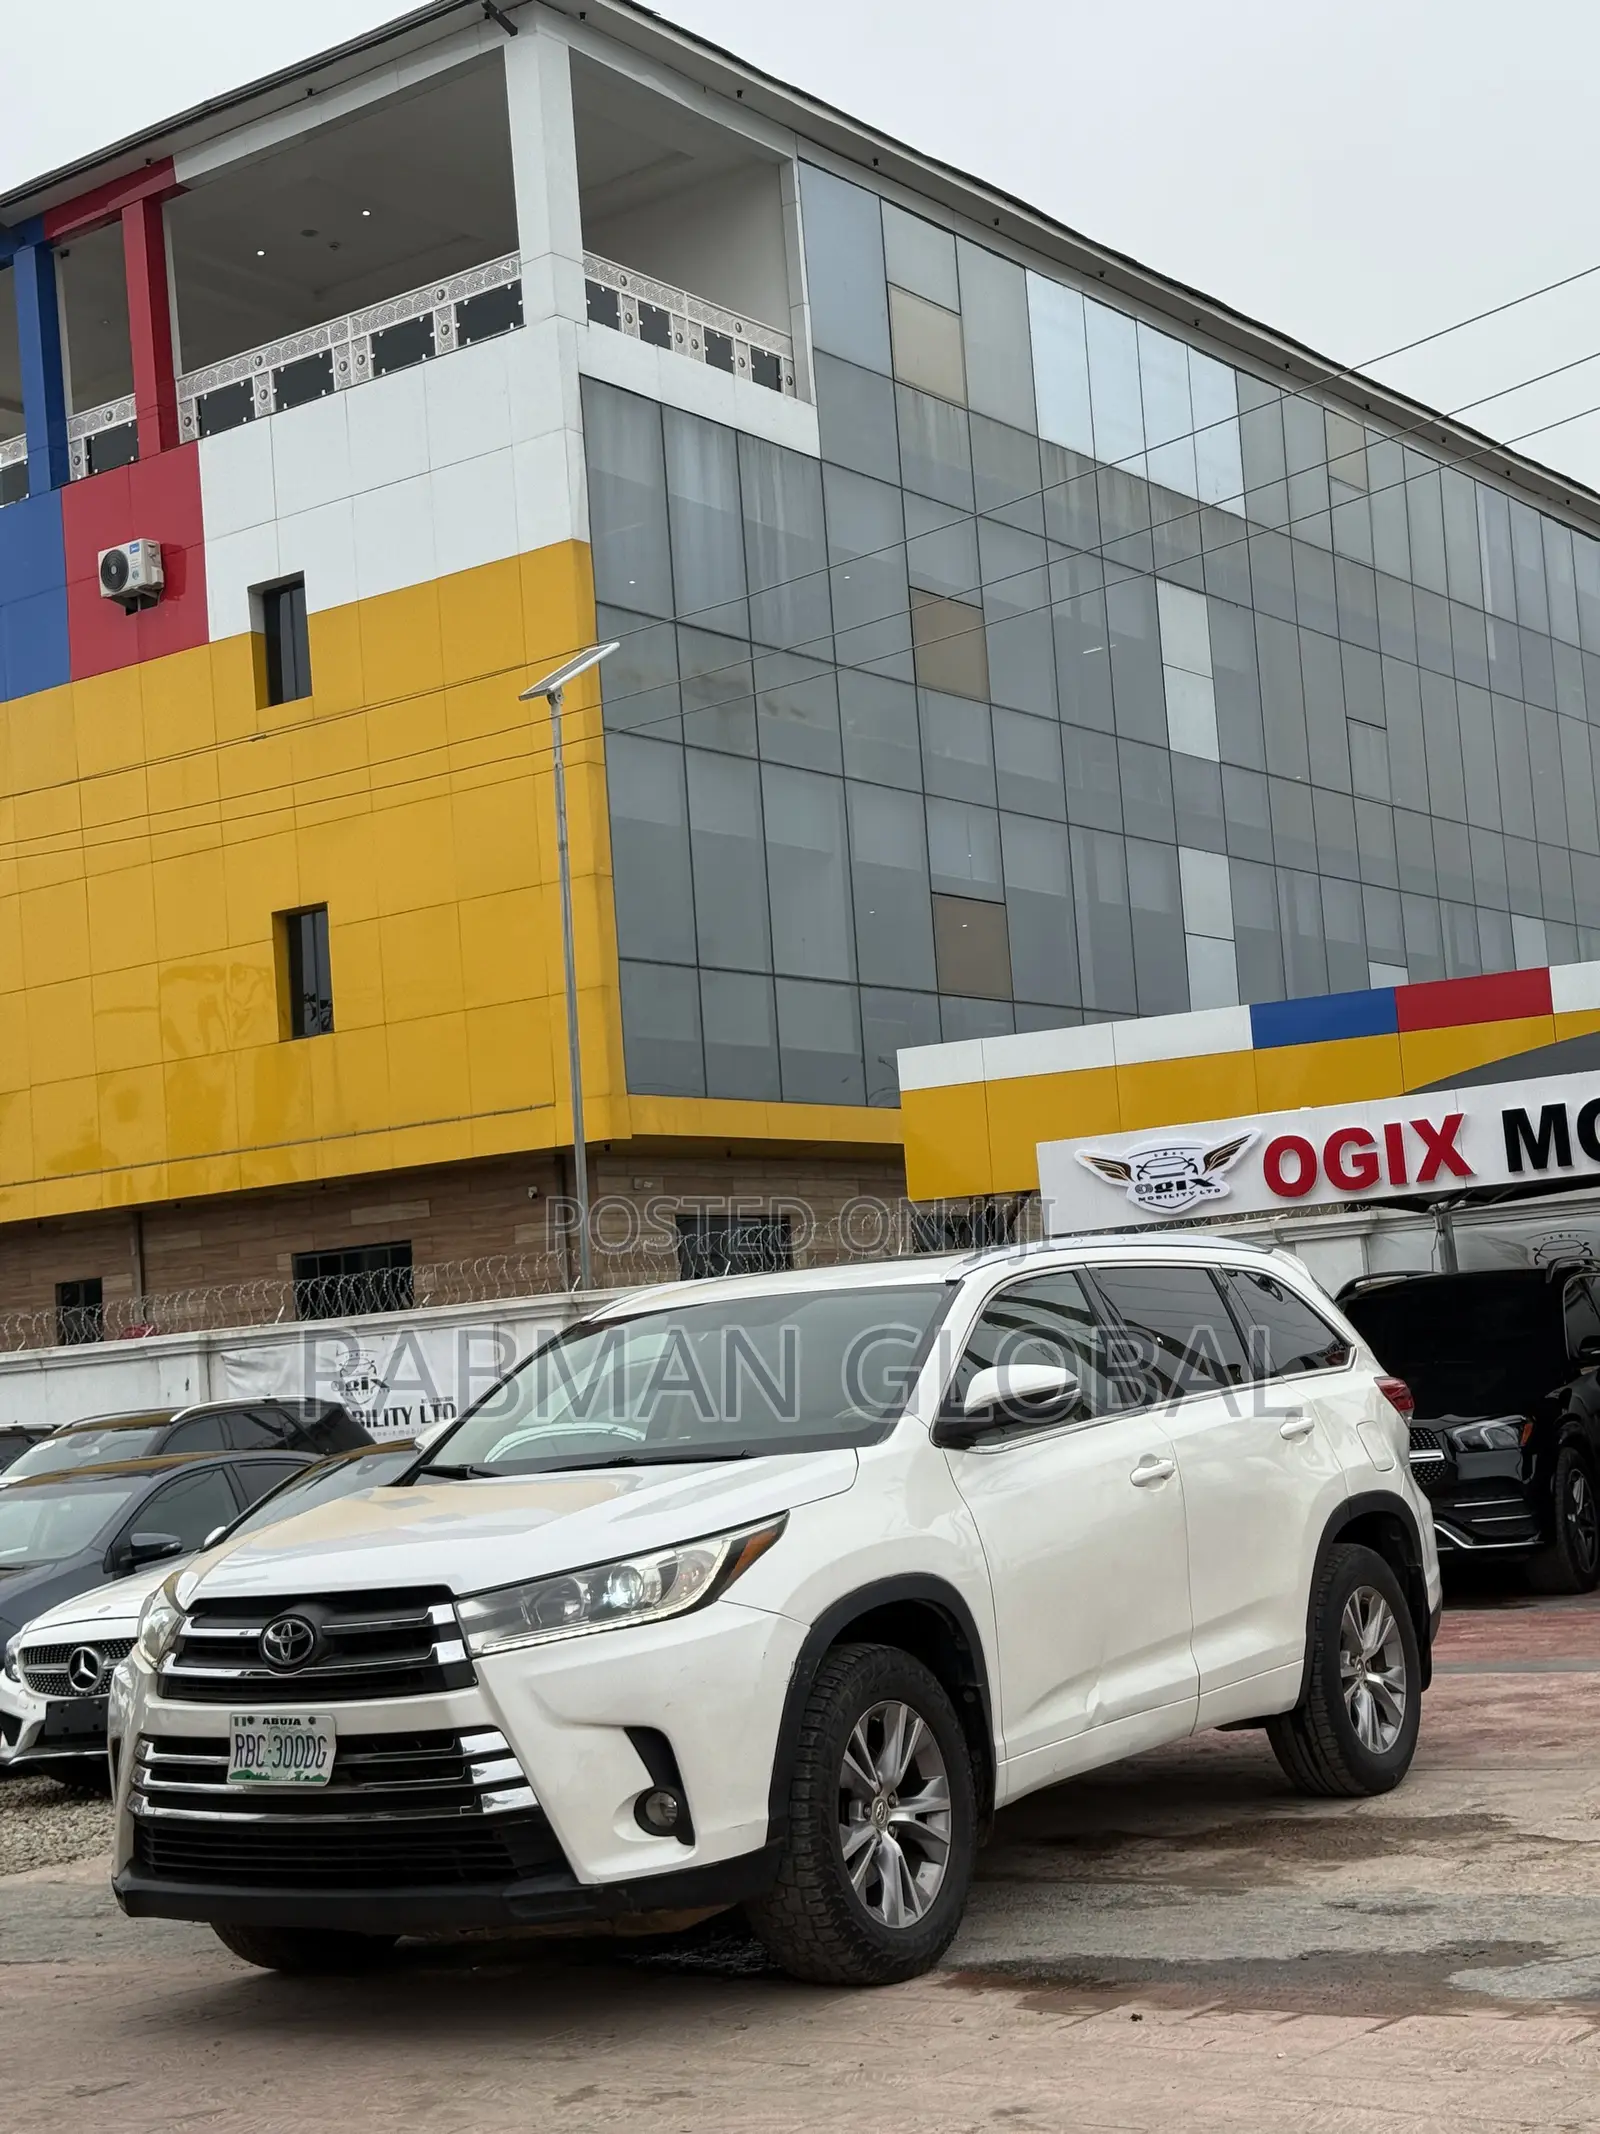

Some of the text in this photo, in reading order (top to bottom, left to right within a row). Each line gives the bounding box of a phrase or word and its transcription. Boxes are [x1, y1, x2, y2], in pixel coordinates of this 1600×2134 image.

[1263, 1112, 1474, 1198] OGIX
[1138, 1190, 1196, 1202] MOBILITY
[420, 1403, 457, 1424] LTD
[262, 1717, 301, 1725] ABUJA
